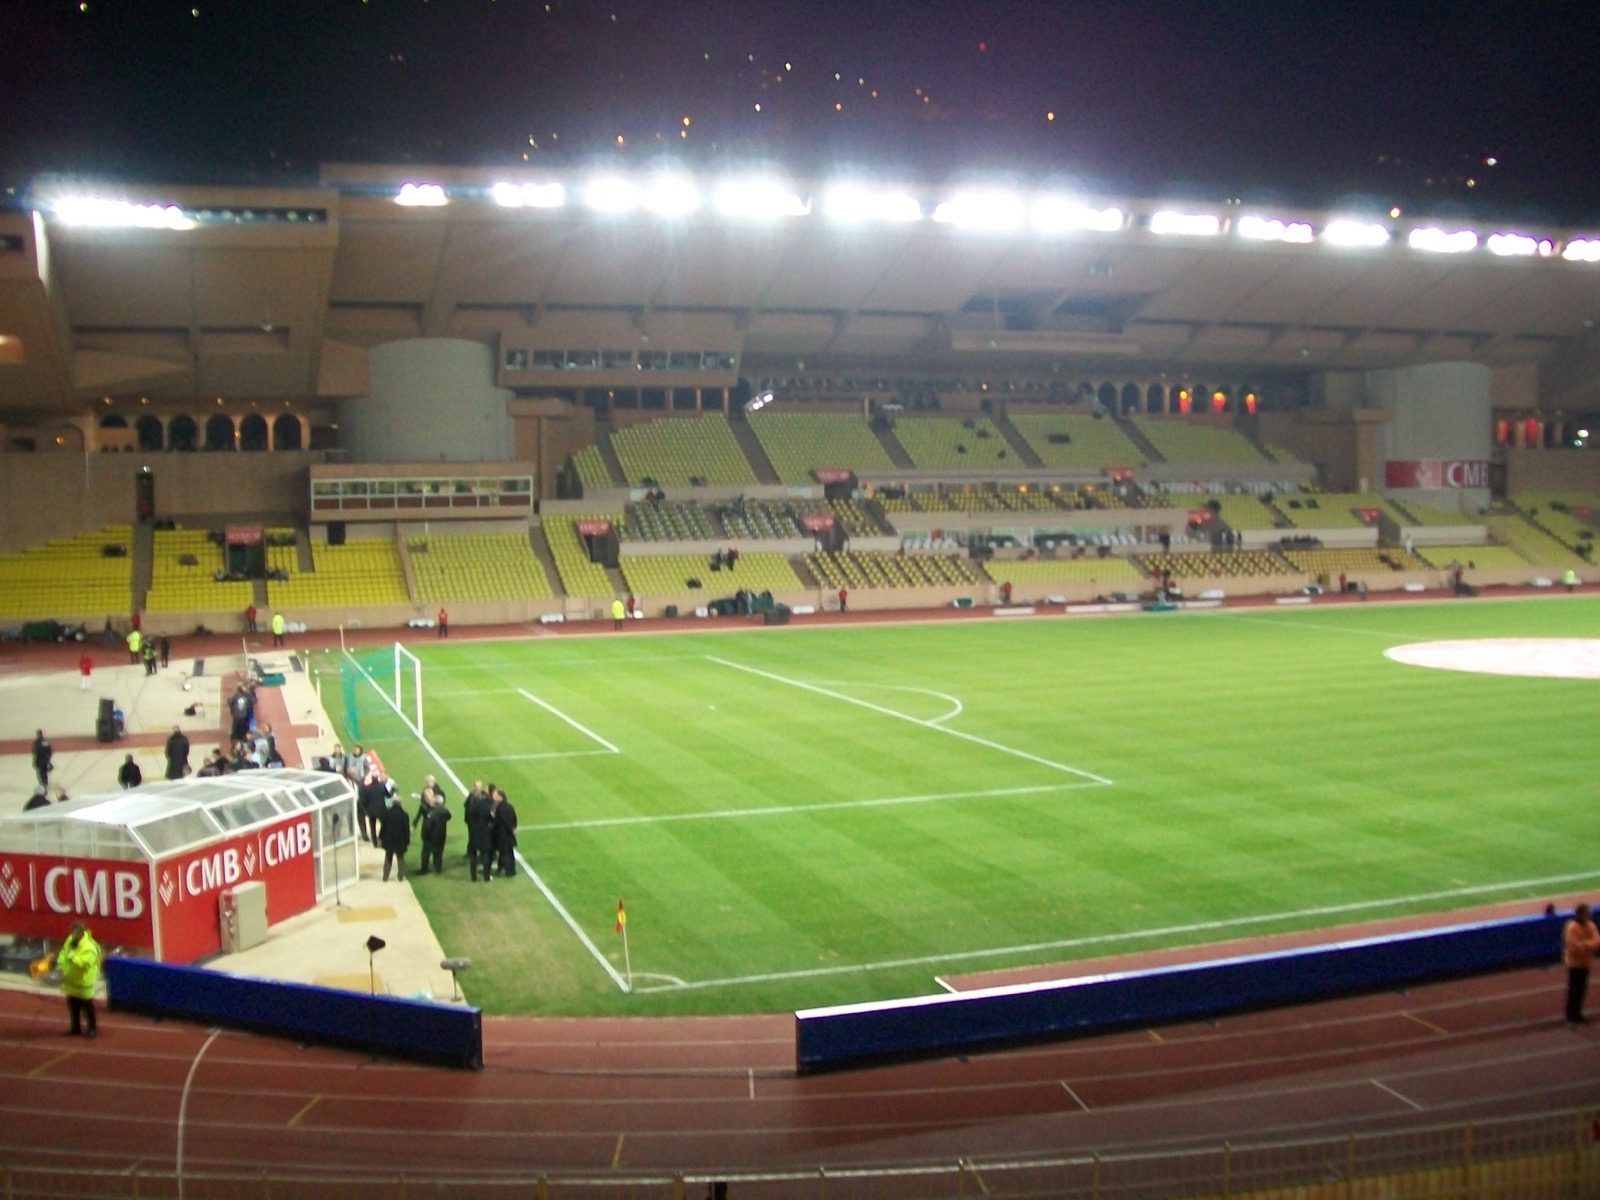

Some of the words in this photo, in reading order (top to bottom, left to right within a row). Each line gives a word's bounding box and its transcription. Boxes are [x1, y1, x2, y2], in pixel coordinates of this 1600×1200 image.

[1447, 461, 1489, 487] CMB
[264, 821, 312, 867] CMB
[44, 866, 144, 919] CMB
[185, 848, 240, 896] CMB
